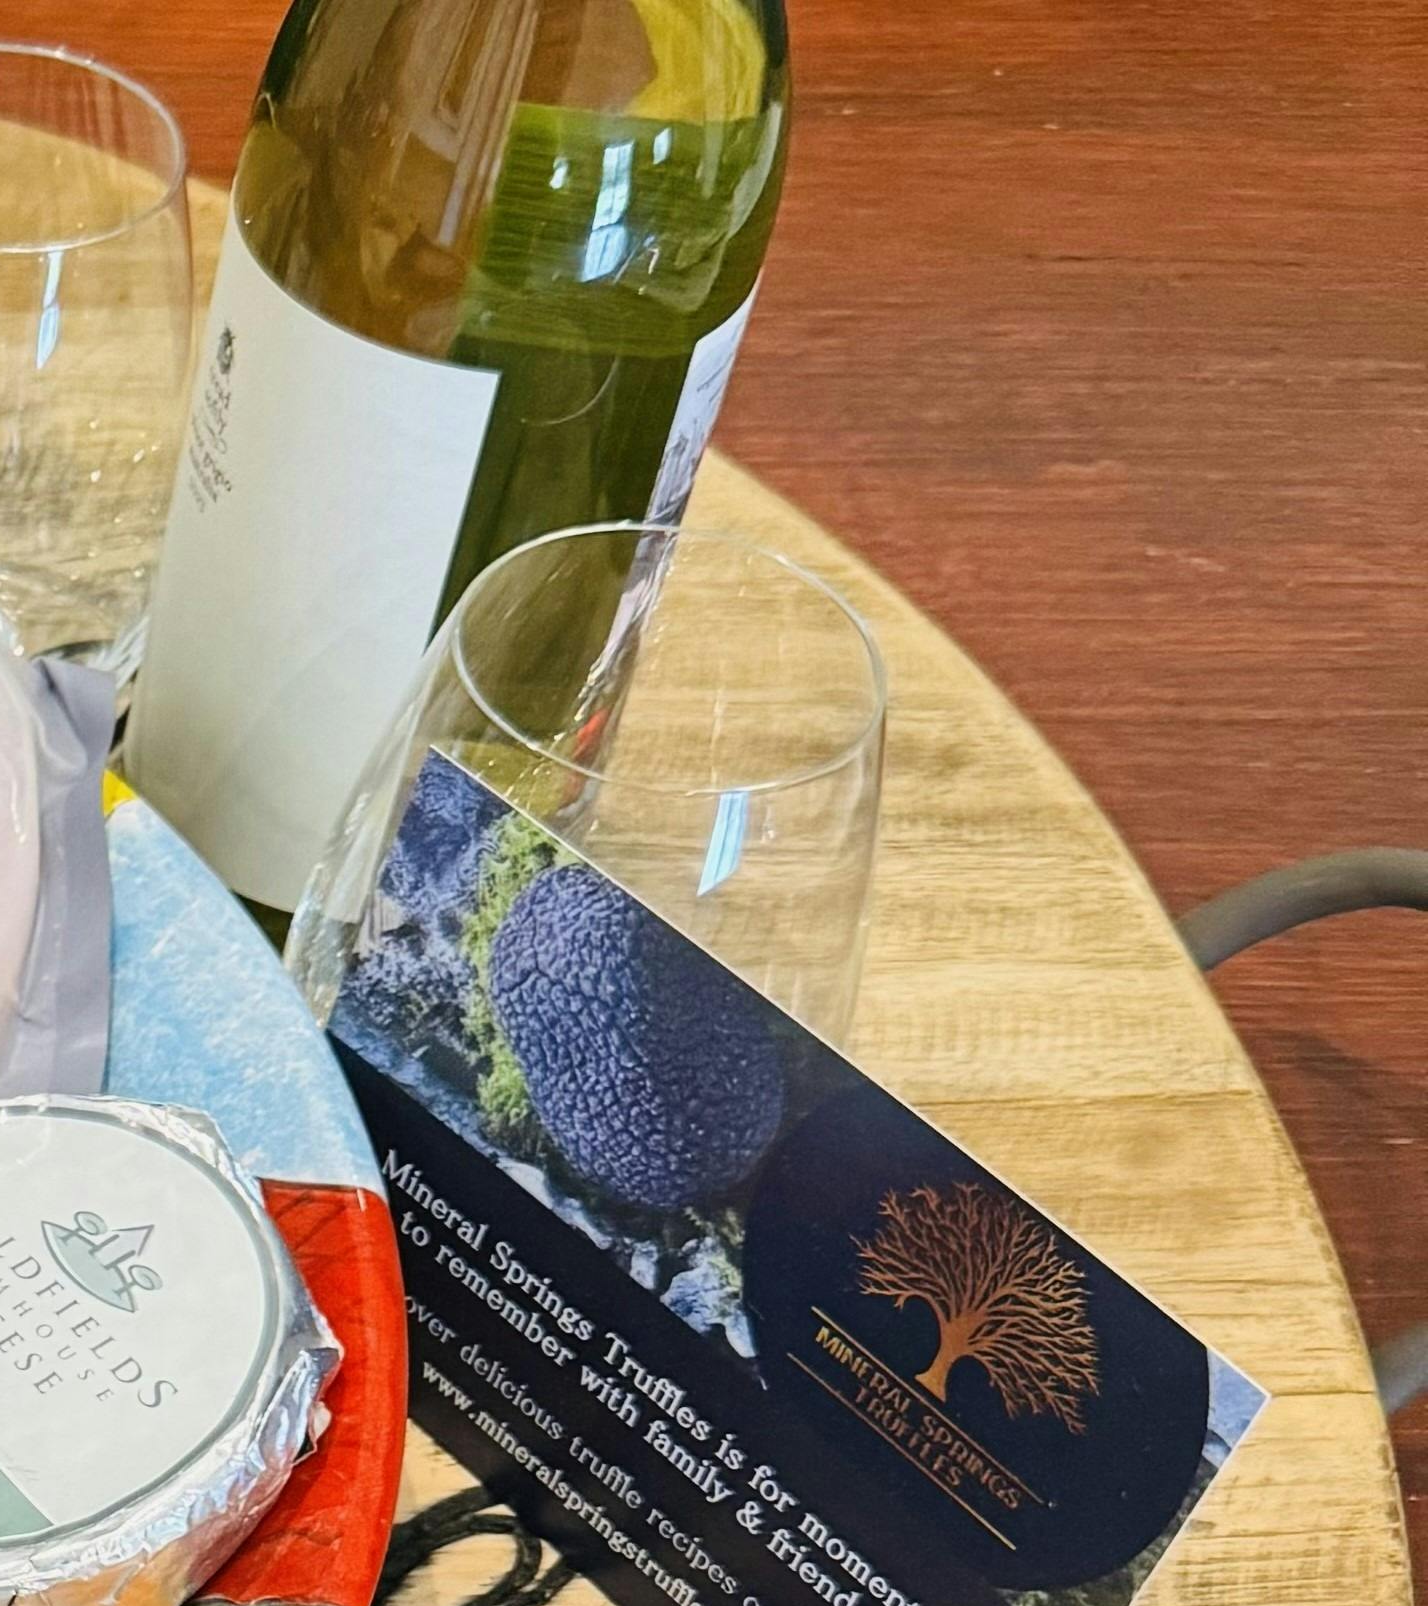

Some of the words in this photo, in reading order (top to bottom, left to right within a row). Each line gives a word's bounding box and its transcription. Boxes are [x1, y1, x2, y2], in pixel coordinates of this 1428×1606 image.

[380, 1148, 489, 1251] Mineral
[489, 1240, 596, 1342] Springs
[604, 1331, 714, 1442] Truffles
[714, 1432, 748, 1471] is
[747, 1463, 799, 1514] for
[400, 1210, 432, 1248] to
[434, 1244, 576, 1368] remember
[579, 1365, 642, 1429] with
[642, 1418, 735, 1504] family
[735, 1500, 766, 1536] &
[459, 1343, 567, 1441] delicious
[568, 1435, 644, 1510] truffle
[646, 1507, 742, 1596] recipes
[815, 1326, 912, 1414] MINERAL
[921, 1415, 1022, 1510] SPRINGS
